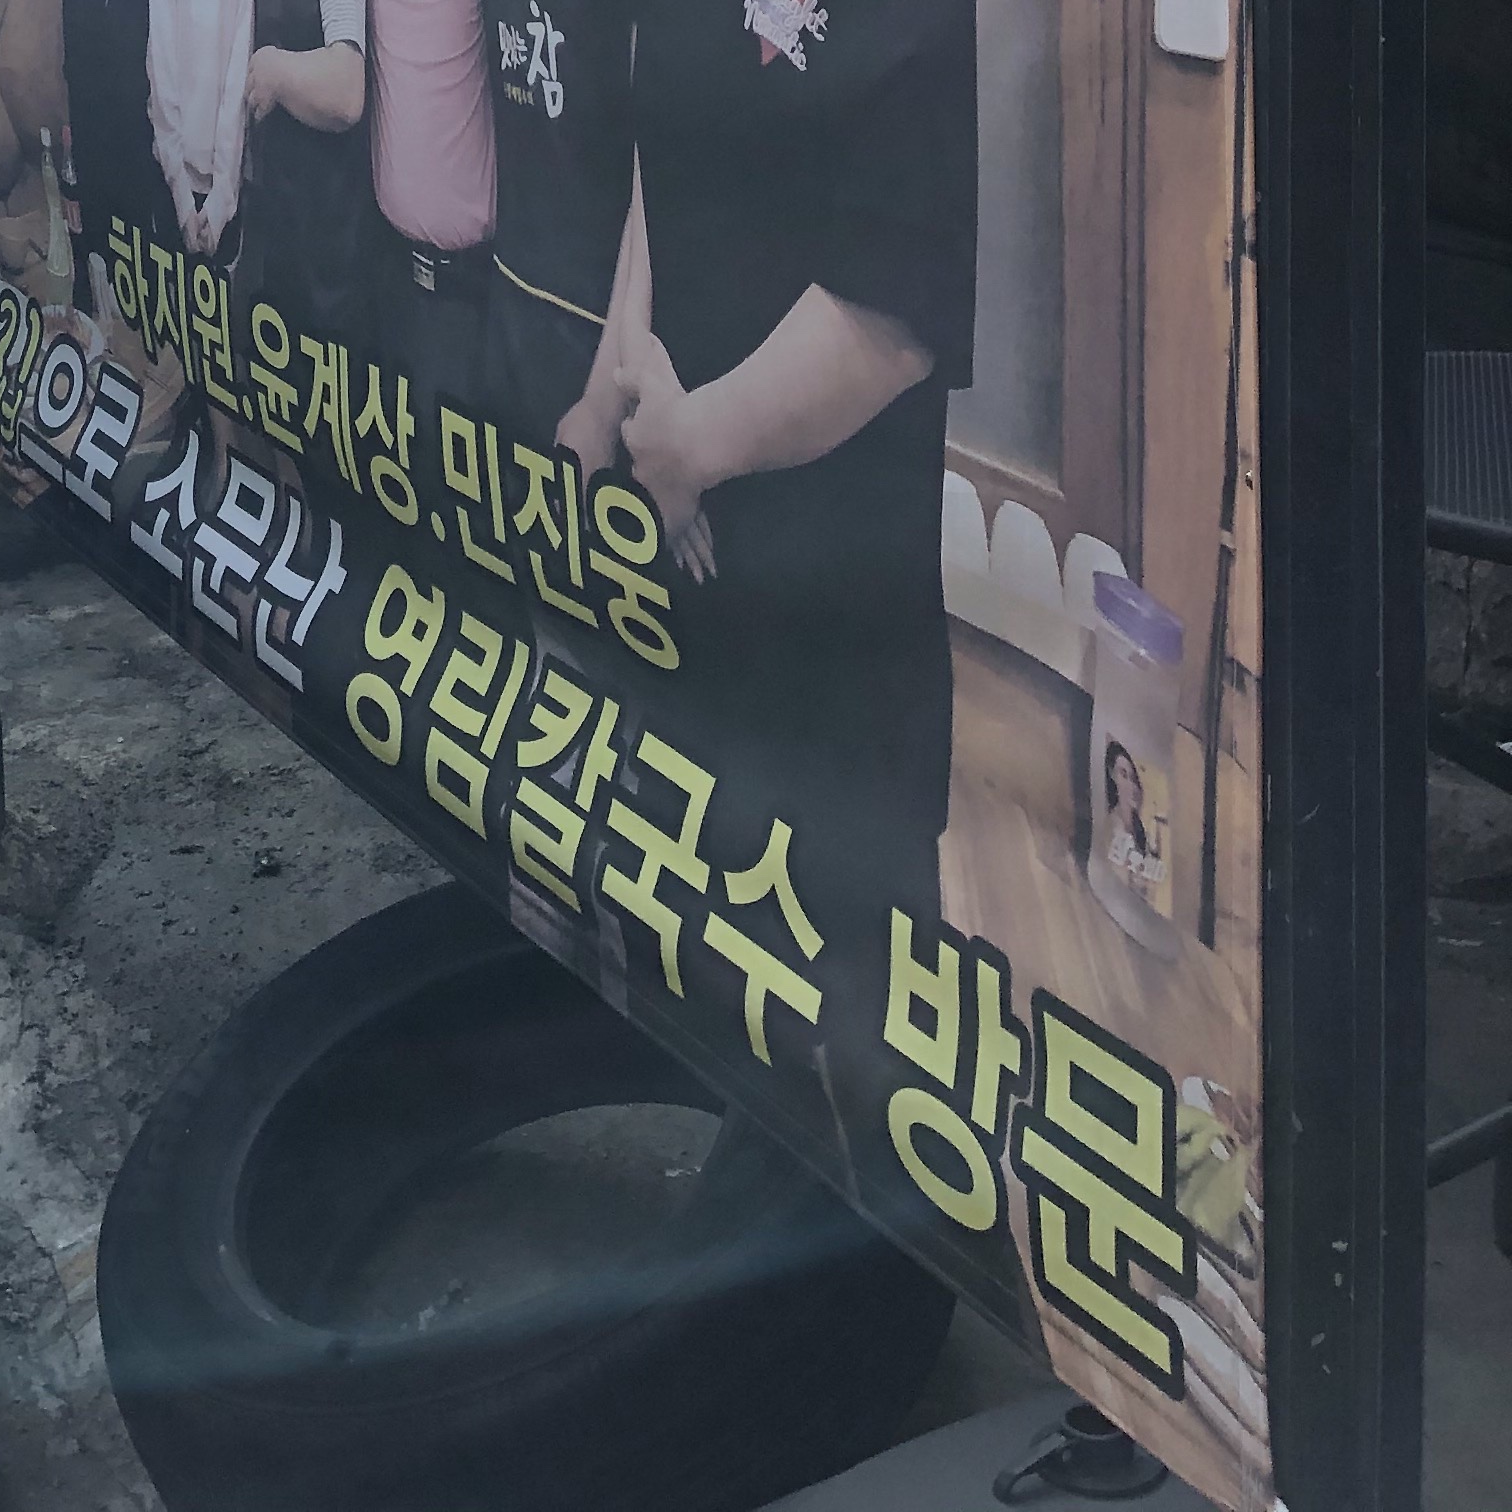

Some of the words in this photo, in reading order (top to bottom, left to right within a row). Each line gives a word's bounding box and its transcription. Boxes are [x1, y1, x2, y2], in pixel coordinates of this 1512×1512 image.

[131, 429, 347, 692] 소문난
[345, 564, 825, 1068] 영림칼국수
[884, 905, 1185, 1376] 방문
